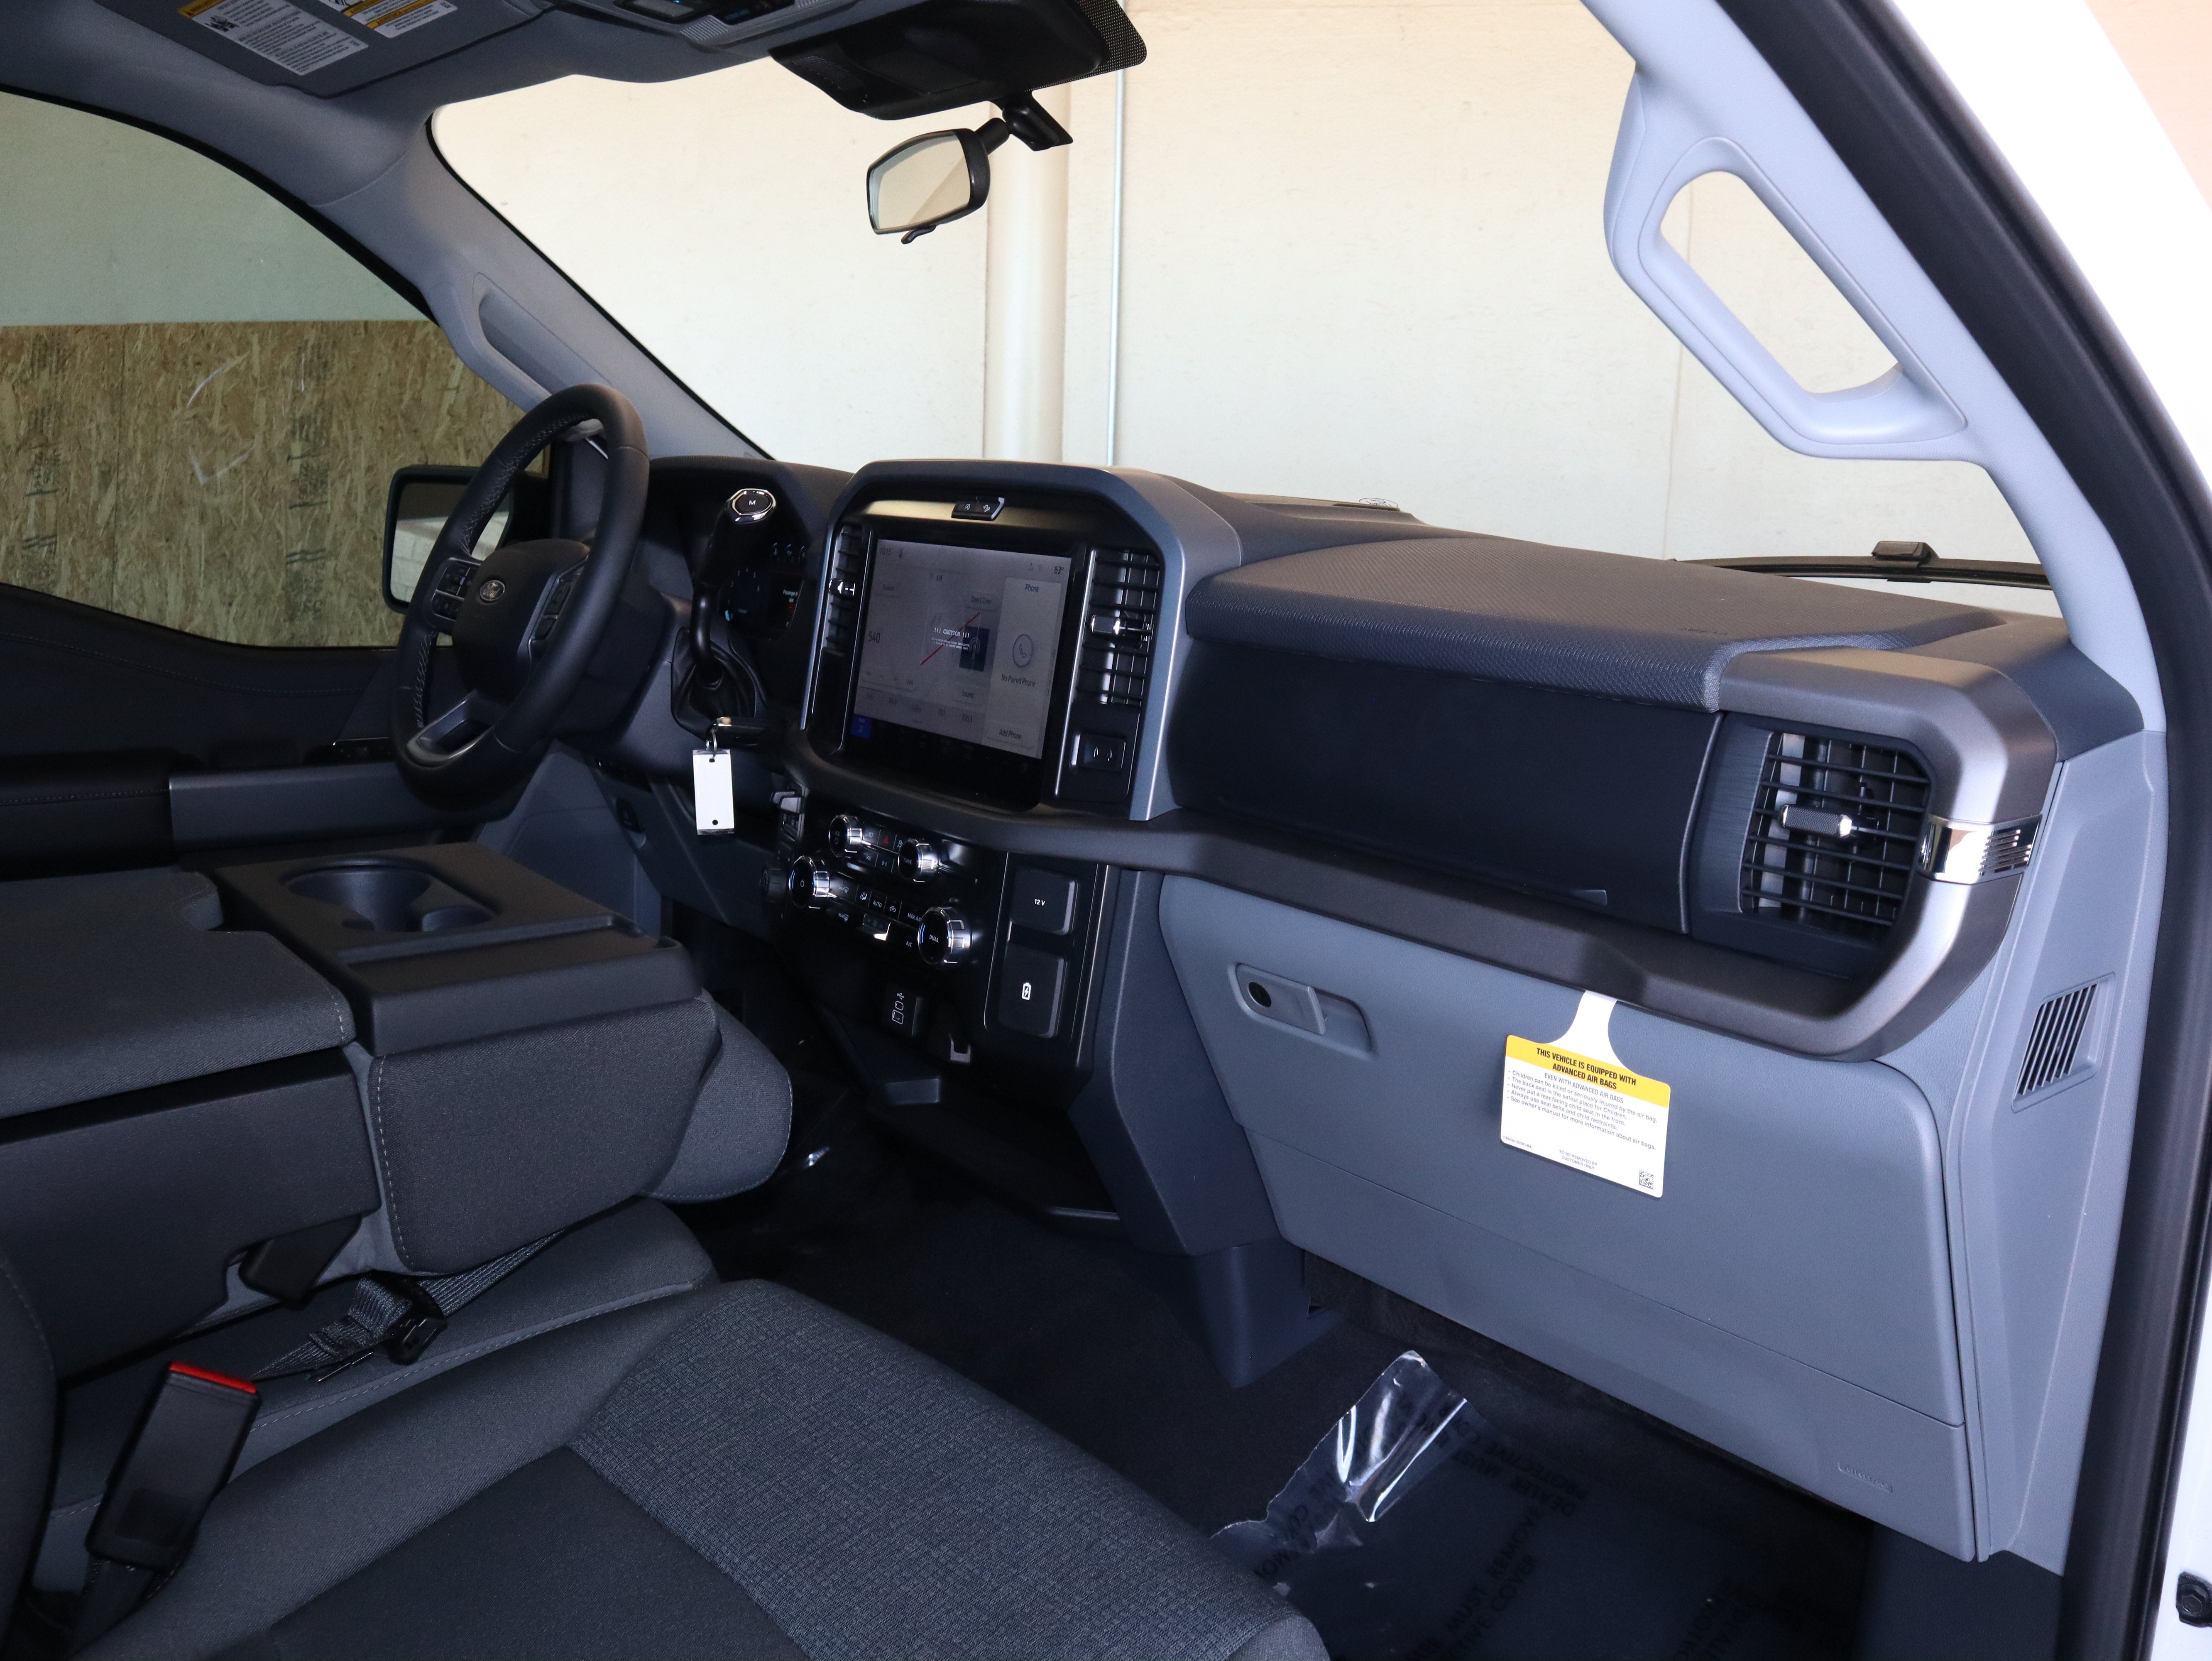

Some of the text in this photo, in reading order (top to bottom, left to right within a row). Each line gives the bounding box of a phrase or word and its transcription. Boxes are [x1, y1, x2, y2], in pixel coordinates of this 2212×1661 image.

[1025, 583, 1039, 593] Phone
[869, 630, 881, 643] 540
[1008, 675, 1022, 685] Paired
[1022, 678, 1036, 687] Phone
[962, 690, 974, 699] Sound
[999, 728, 1022, 740] Add Phone
[929, 934, 939, 943] DUAL
[1537, 1047, 1636, 1086] THIS VEHICLE IS EQUIPPED WITH
[1552, 1063, 1617, 1090] ADVANCED AIR BAGS
[1512, 1070, 1533, 1081] Children
[1552, 1083, 1566, 1093] killed
[1574, 1092, 1598, 1104] seriously
[1599, 1099, 1618, 1110] injured
[1512, 1083, 1526, 1092] Never
[1552, 1097, 1568, 1107] facing
[1522, 1080, 1534, 1088] back
[1562, 1095, 1578, 1103] safest
[1579, 1100, 1593, 1108] place
[1544, 1073, 1557, 1082] EVEN
[1558, 1077, 1571, 1086] WITH
[1572, 1082, 1598, 1095] ADVANCED
[1610, 1094, 1624, 1103] BAGS
[1511, 1090, 1529, 1100] Always
[1552, 1103, 1565, 1112] belts
[1542, 1107, 1561, 1117] manual
[1584, 1121, 1615, 1136] information
[1616, 1133, 1631, 1142] about
[1561, 1155, 1583, 1166] CUSTOMER
[1571, 1154, 1591, 1164] REMOVED
